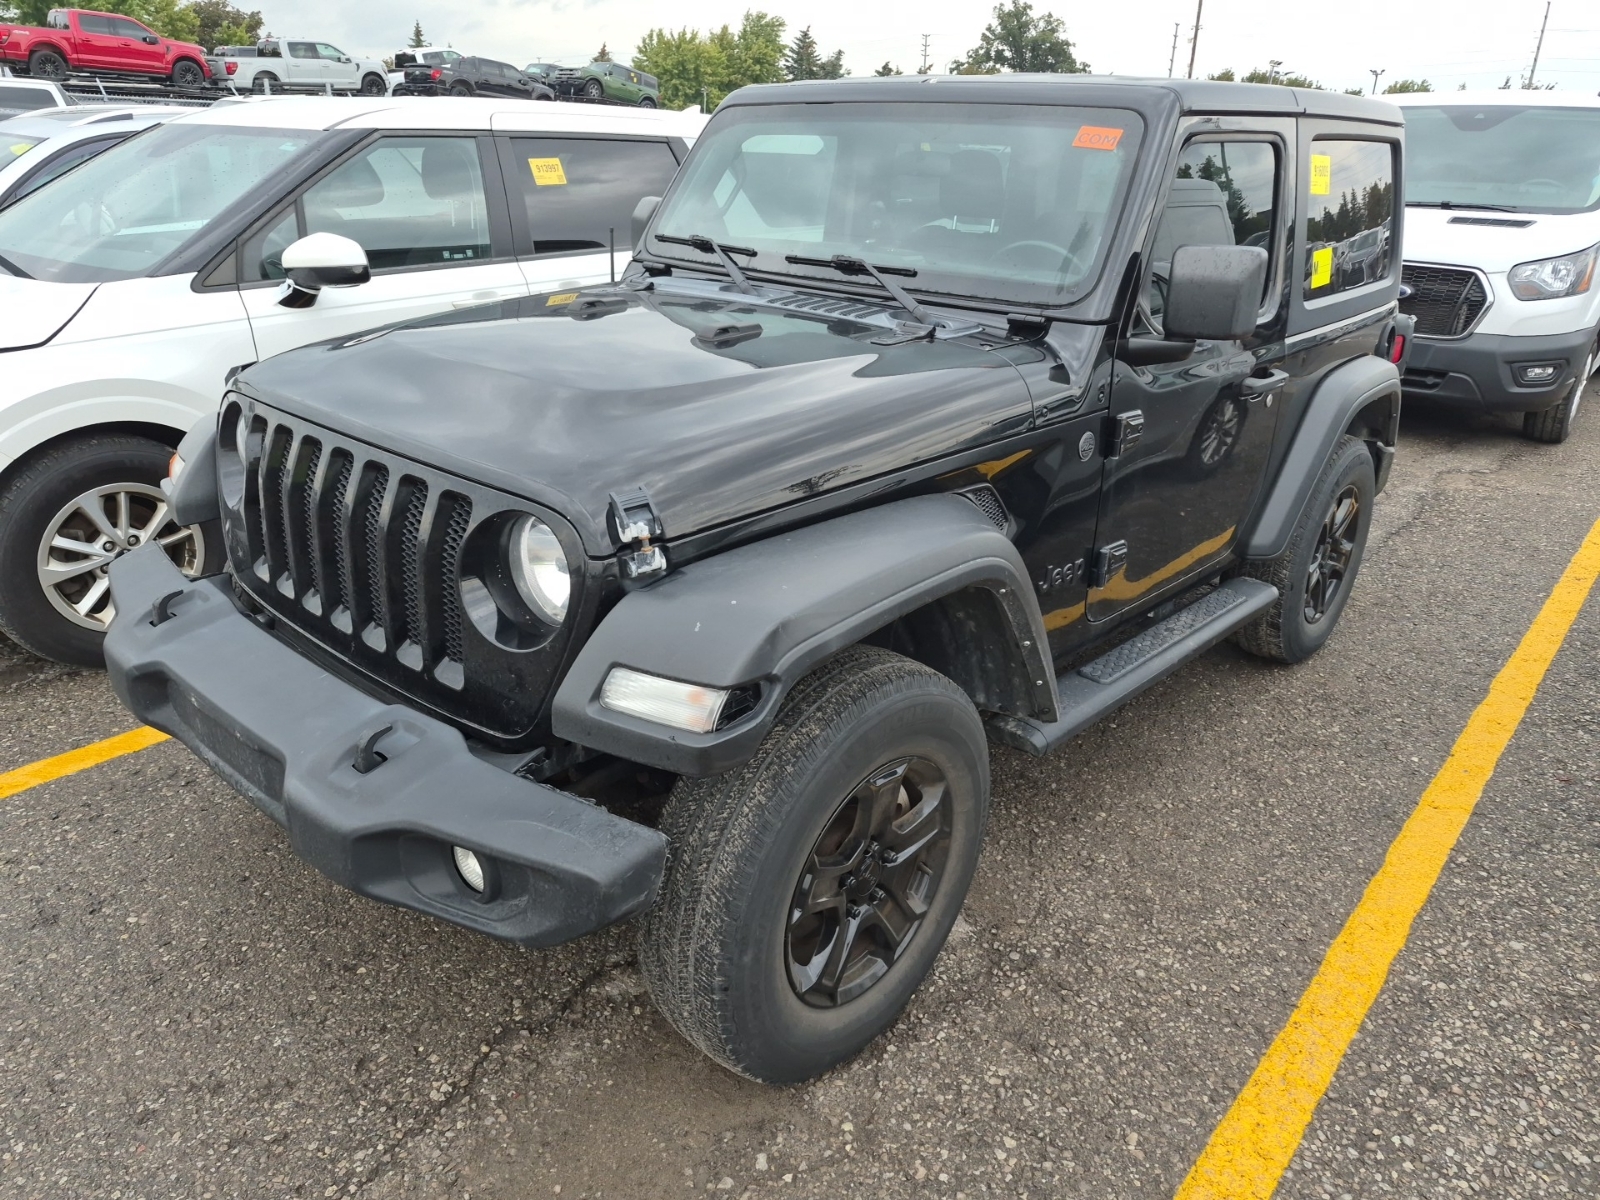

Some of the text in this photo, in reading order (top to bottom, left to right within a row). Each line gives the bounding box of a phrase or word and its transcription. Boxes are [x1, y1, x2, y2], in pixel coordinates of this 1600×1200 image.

[1078, 132, 1117, 147] COM
[535, 163, 560, 173] 913997
[1038, 558, 1085, 592] Jeep
